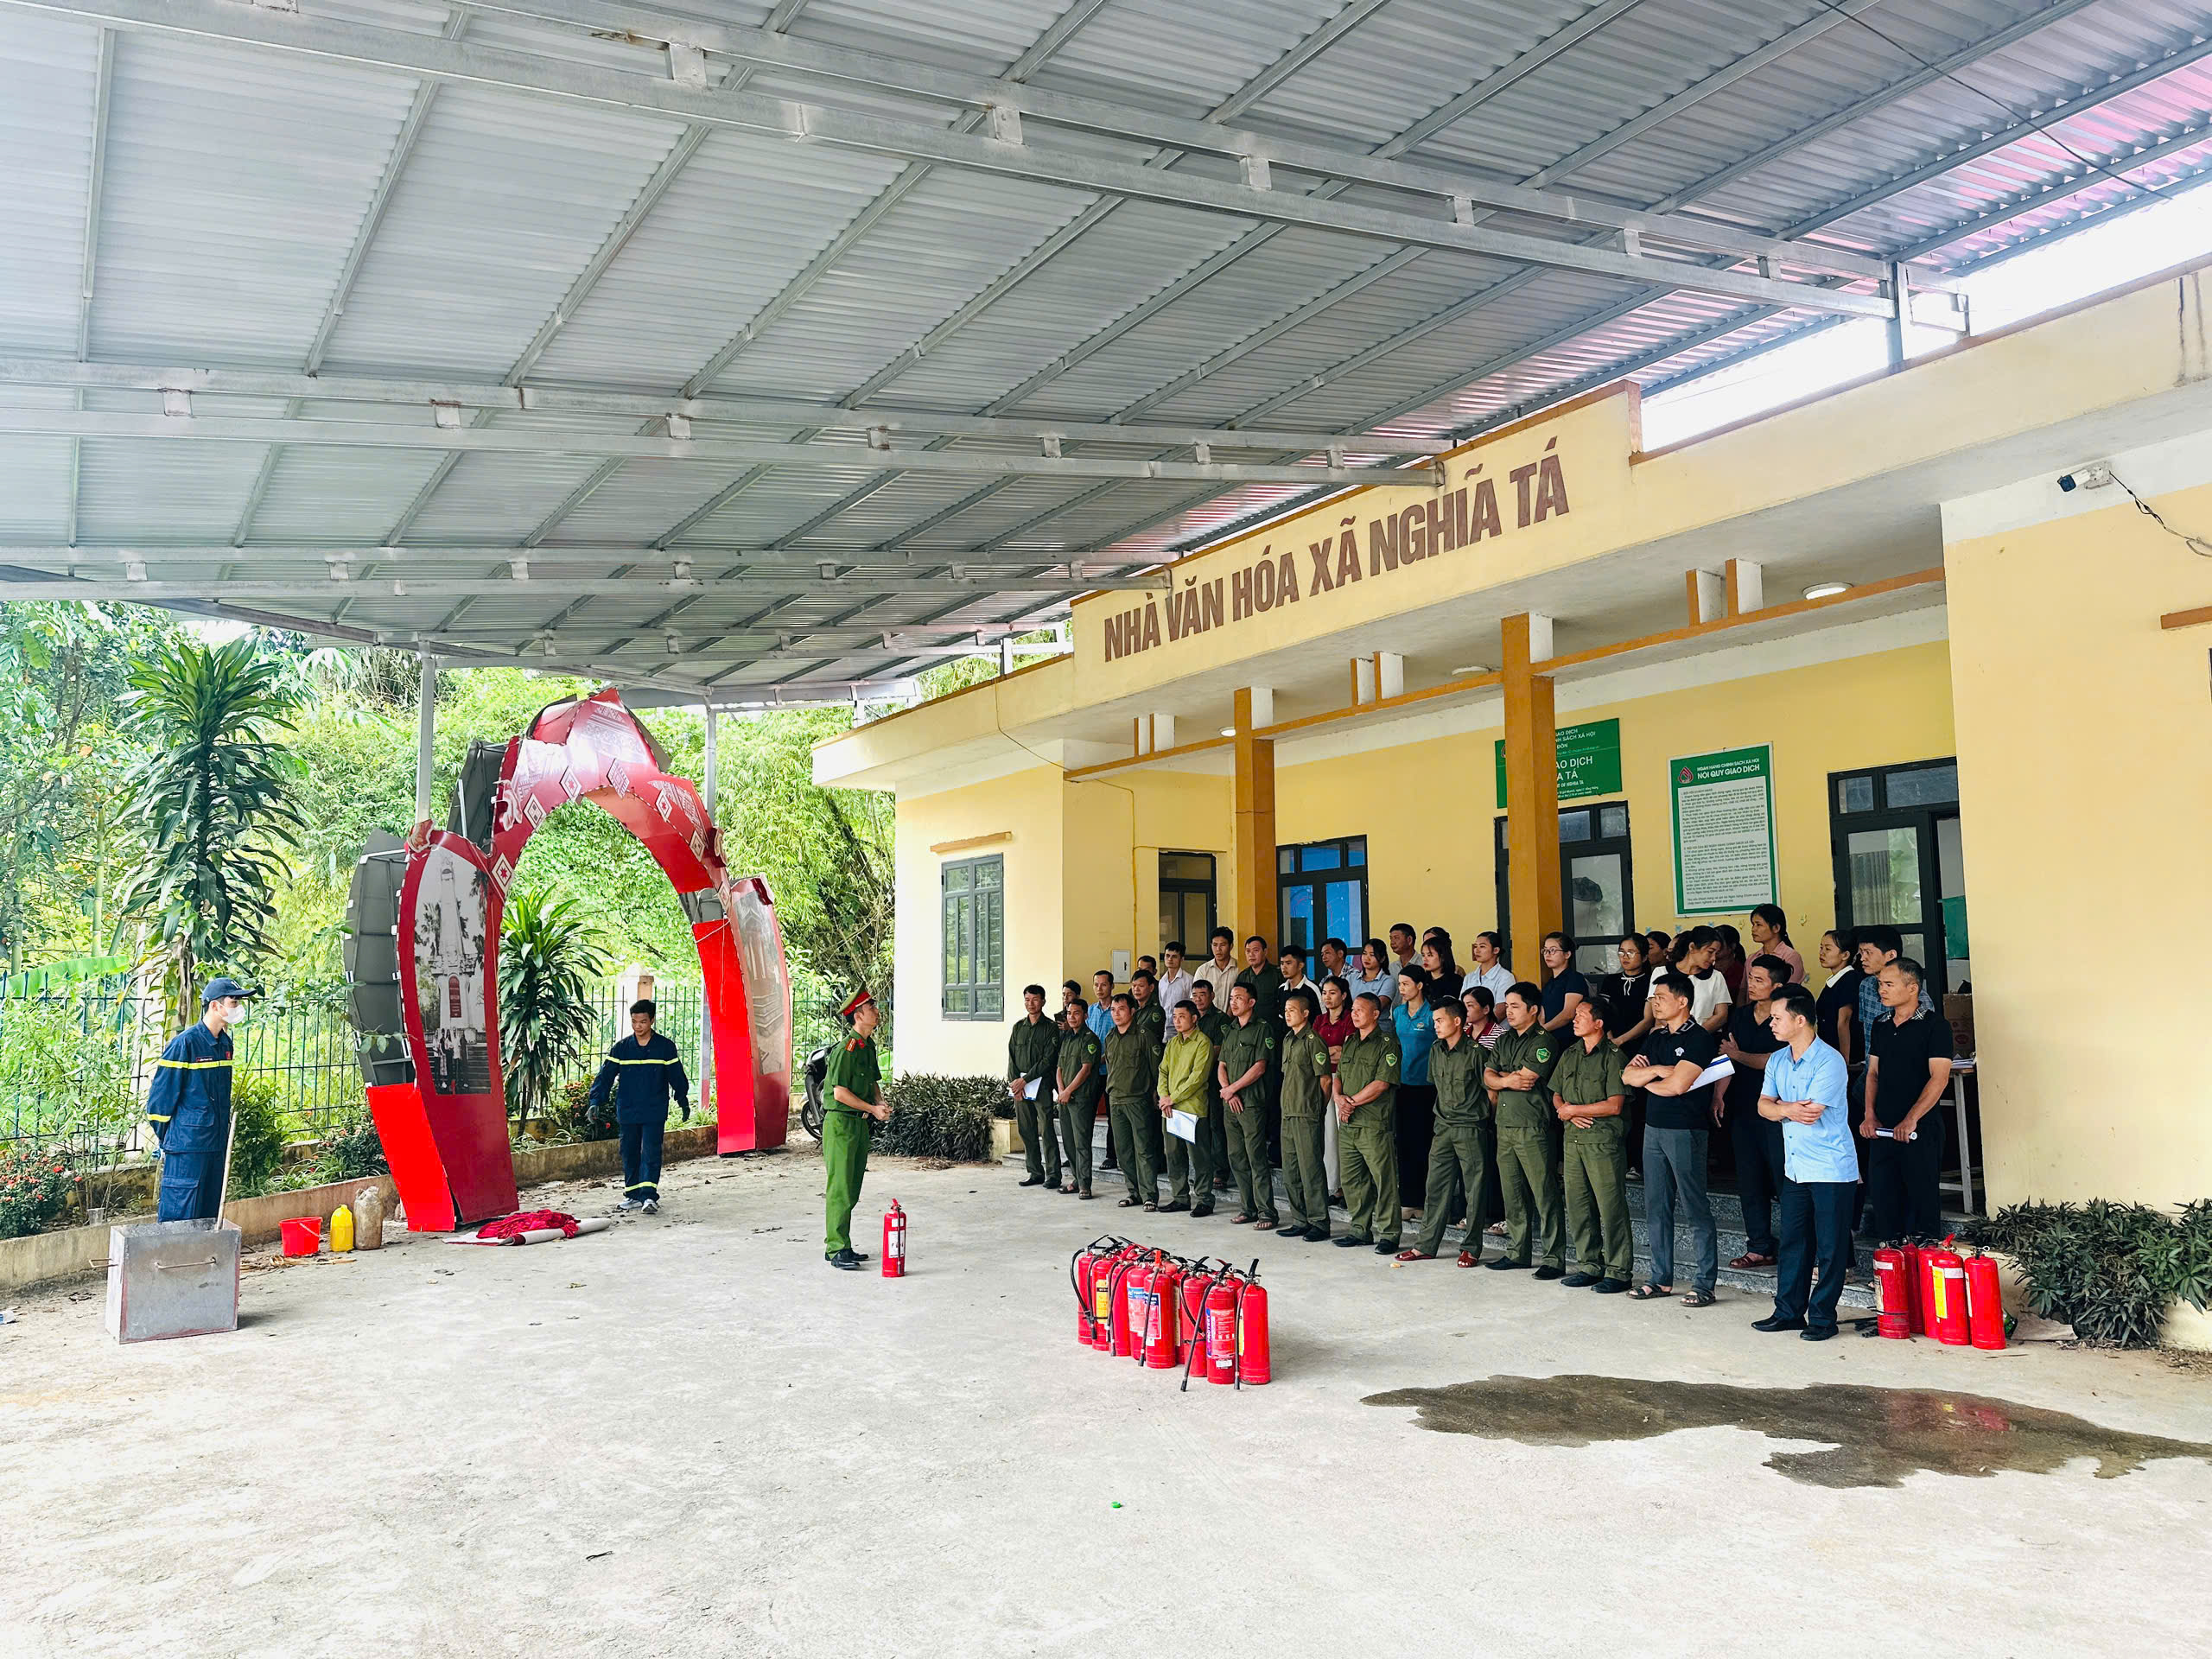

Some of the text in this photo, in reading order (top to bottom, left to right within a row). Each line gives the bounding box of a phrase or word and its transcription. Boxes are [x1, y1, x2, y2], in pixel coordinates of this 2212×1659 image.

[1104, 436, 1570, 662] NHÀ VĂN HÓA XÃ NGHĨA TÁ
[1570, 756, 1593, 768] DỊCH
[1565, 768, 1578, 779] TÁ
[1725, 767, 1742, 775] GIAO
[1743, 764, 1760, 772] DỊCH
